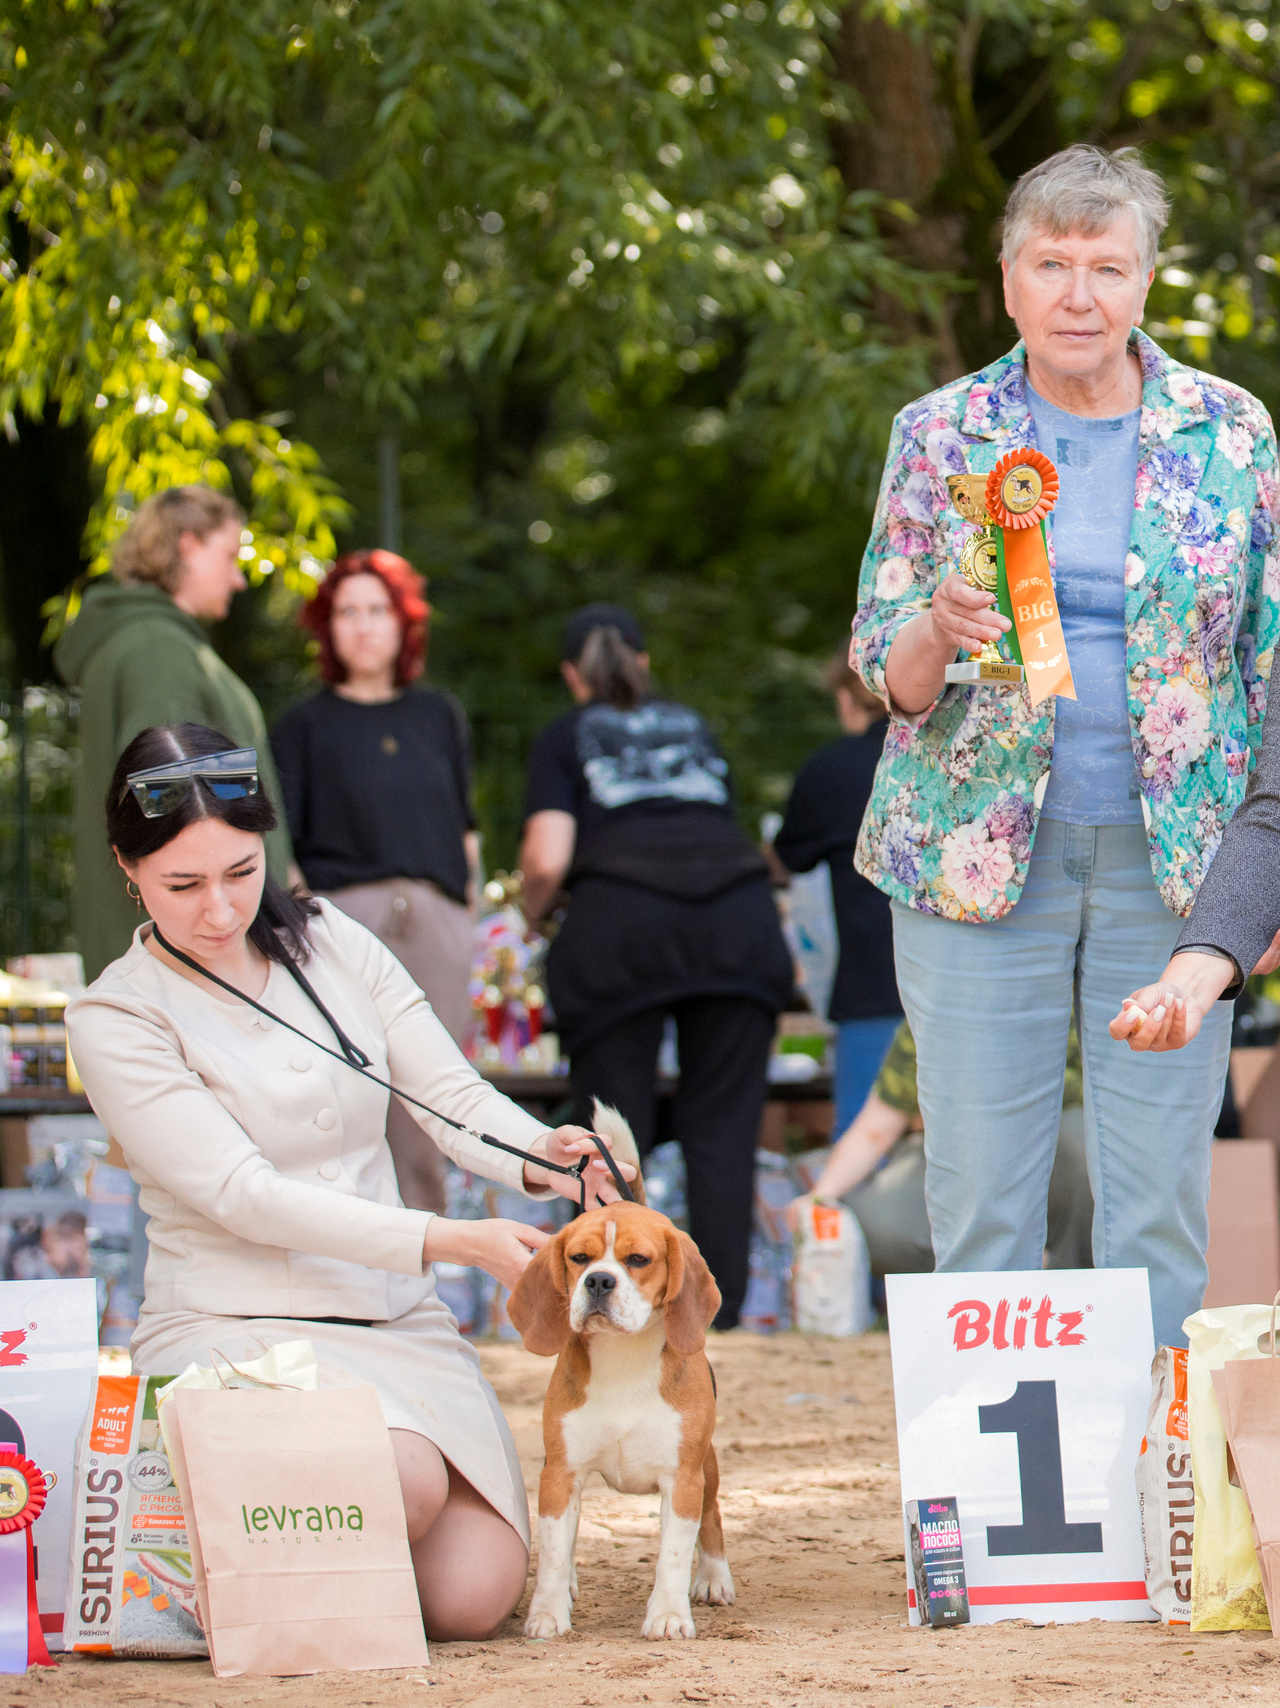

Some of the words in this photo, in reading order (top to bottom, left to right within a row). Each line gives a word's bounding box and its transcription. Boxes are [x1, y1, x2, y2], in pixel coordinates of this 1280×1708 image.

[1017, 600, 1055, 623] BIG
[1035, 632, 1048, 648] 1
[947, 1294, 1088, 1352] Blitz
[97, 1418, 126, 1432] ADULT
[138, 1465, 167, 1478] 44%
[978, 1380, 1104, 1557] 1
[150, 1504, 183, 1512] РИСО
[242, 1504, 363, 1534] levrana
[922, 1520, 958, 1535] МАСЛО
[1167, 1453, 1195, 1603] SIRIUS
[80, 1468, 123, 1624] SIRIUS
[248, 1535, 361, 1544] NATURAL
[924, 1533, 960, 1548] ЛОСОСЯ
[934, 1577, 954, 1586] OMEGA
[954, 1576, 959, 1584] 3
[1173, 1607, 1190, 1615] PREM
